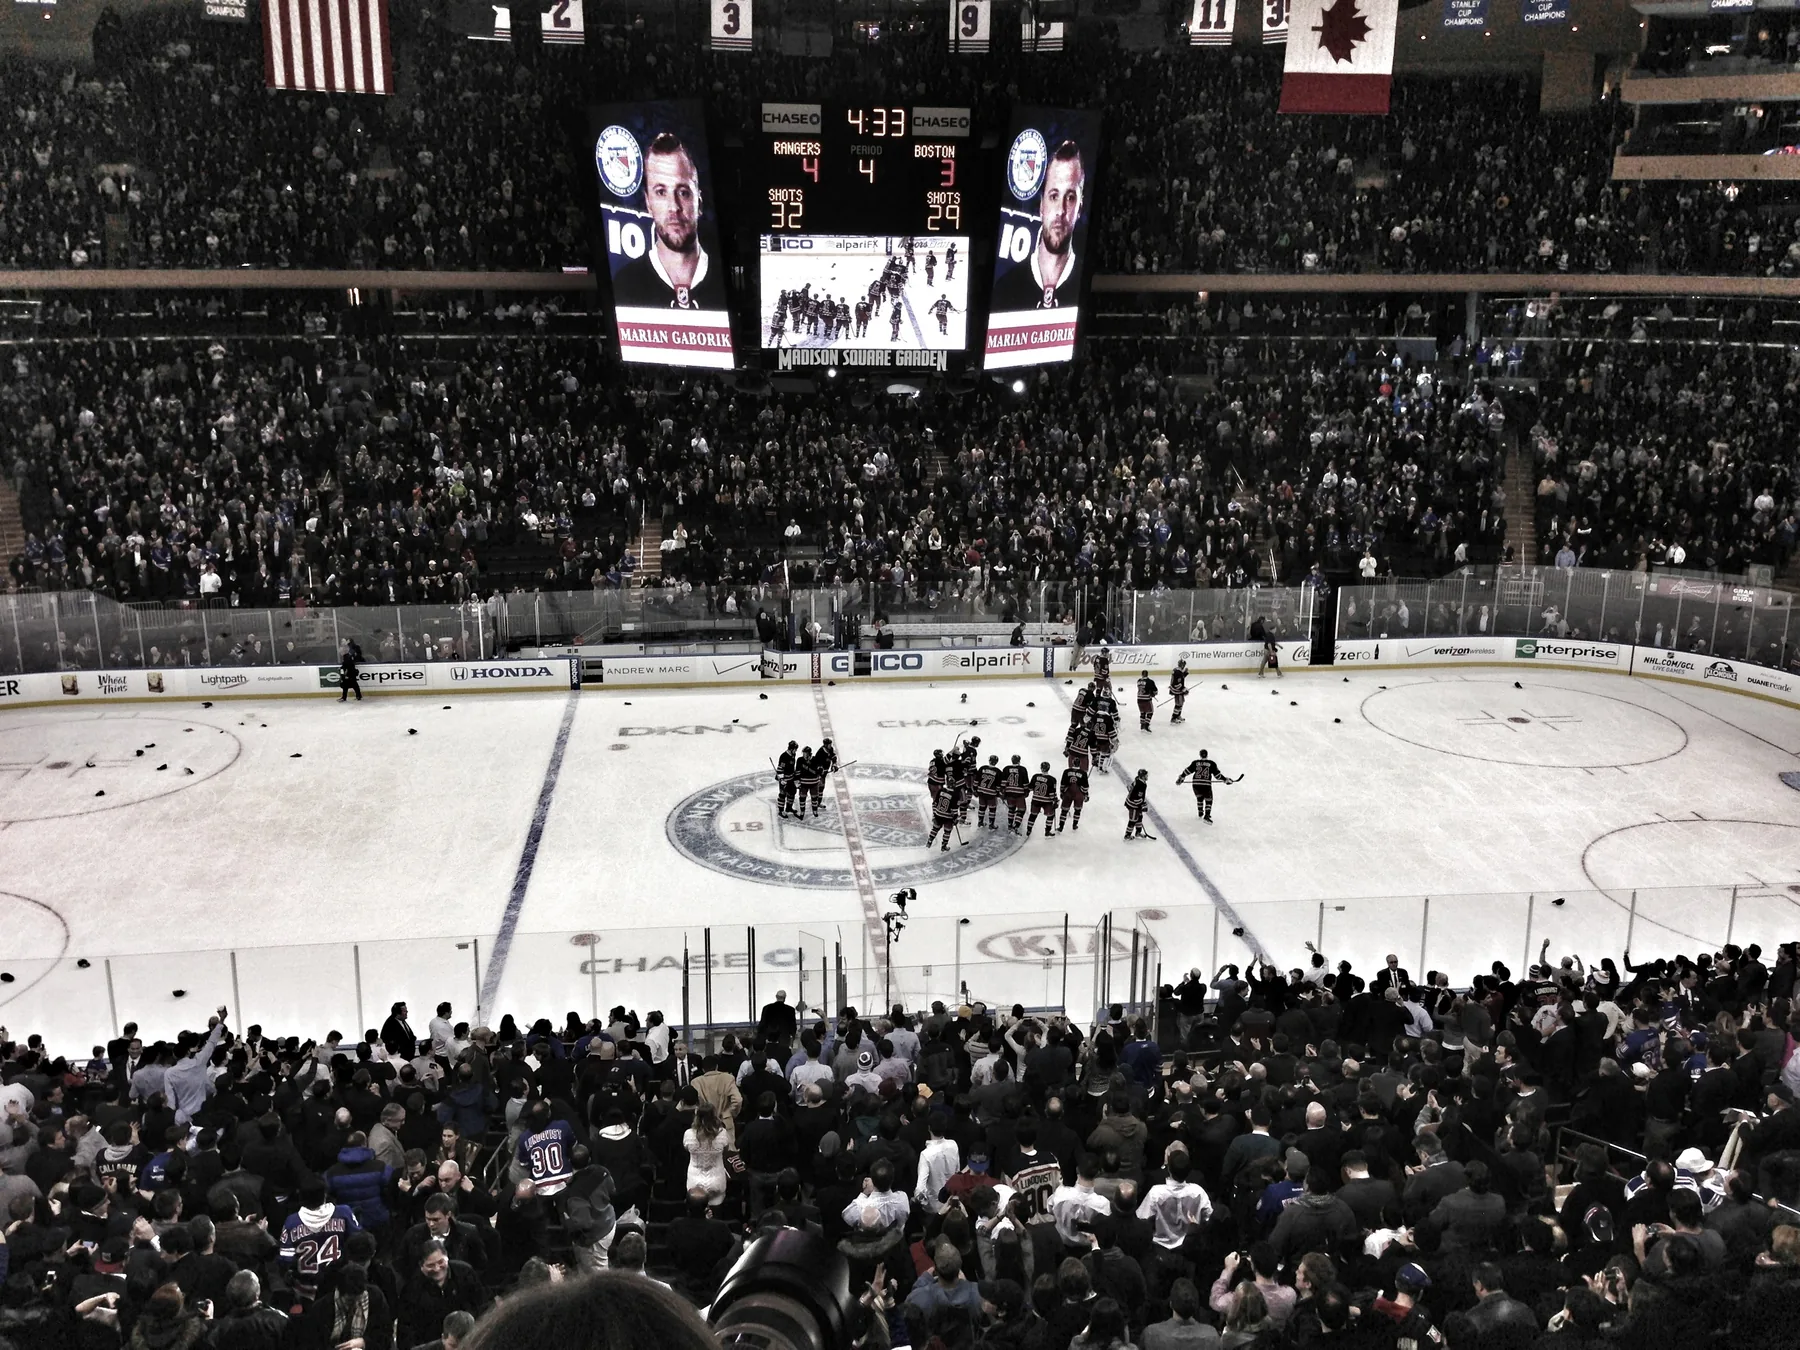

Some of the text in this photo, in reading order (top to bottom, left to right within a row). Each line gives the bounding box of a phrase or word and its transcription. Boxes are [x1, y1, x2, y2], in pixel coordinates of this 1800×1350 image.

[206, 5, 246, 18] CHAMPIONS
[1451, 0, 1480, 9] STANLEY
[1538, 3, 1553, 12] CUP
[553, 0, 571, 28] 2
[723, 3, 740, 35] 3
[1199, 0, 1226, 30] 11
[1458, 9, 1472, 17] CUP
[1524, 11, 1566, 21] CHAMPIONS
[961, 5, 979, 37] 9
[1444, 18, 1484, 27] CHAMPIONS
[762, 113, 809, 125] CHASE
[848, 108, 905, 137] 4:33
[913, 116, 958, 129] CHASE
[774, 141, 821, 155] RANGERS
[850, 144, 883, 156] PERIOD
[914, 145, 955, 158] BOSTON
[803, 158, 819, 183] 4
[859, 159, 874, 184] 4
[940, 159, 955, 187] 3
[768, 188, 803, 201] SHOTS
[927, 192, 961, 205] SHOTS
[771, 202, 803, 229] 32
[927, 205, 960, 231] 29
[608, 219, 646, 260] 10
[760, 239, 814, 250] GICO
[835, 238, 879, 252] alpariFX
[998, 223, 1032, 263] 10
[620, 327, 732, 348] MARIAN GABORIK
[987, 327, 1075, 349] MARIAN GABORIK
[778, 349, 948, 372] MADISON SQUARE GARDEN
[1112, 650, 1157, 665] LIGHT
[1190, 649, 1268, 659] Time Warner Cabl
[1339, 648, 1371, 660] zero
[1520, 641, 1617, 660] enterprise
[831, 652, 923, 672] GICO
[960, 651, 1031, 672] alpariFX
[1643, 656, 1695, 671] NHL.COM/GCL
[325, 669, 424, 683] eerprise
[470, 666, 553, 679] HONDA
[607, 665, 690, 675] ANDREW MARC
[1666, 667, 1685, 675] GAMES
[1704, 667, 1738, 682] KLONDIKE
[97, 673, 128, 685] Wheat
[201, 674, 247, 686] Lightpath
[97, 684, 128, 695] Thins
[618, 722, 769, 737] DKNY
[877, 718, 991, 728] CHASE
[1007, 772, 1020, 787] 41
[1194, 767, 1210, 779] 24
[981, 774, 996, 788] 27
[1034, 782, 1048, 797] 20
[686, 788, 735, 819] NEW
[938, 797, 951, 813] 19
[729, 821, 764, 833] 19
[711, 850, 811, 882] MADISON
[1010, 931, 1132, 957] KIA
[579, 951, 750, 975] CHASE
[524, 1128, 563, 1152] LUNDQVIST
[530, 1141, 564, 1179] 30
[1020, 1173, 1052, 1190] LUNDQVIST
[290, 1218, 346, 1243] CALHAN
[296, 1234, 342, 1274] 24
